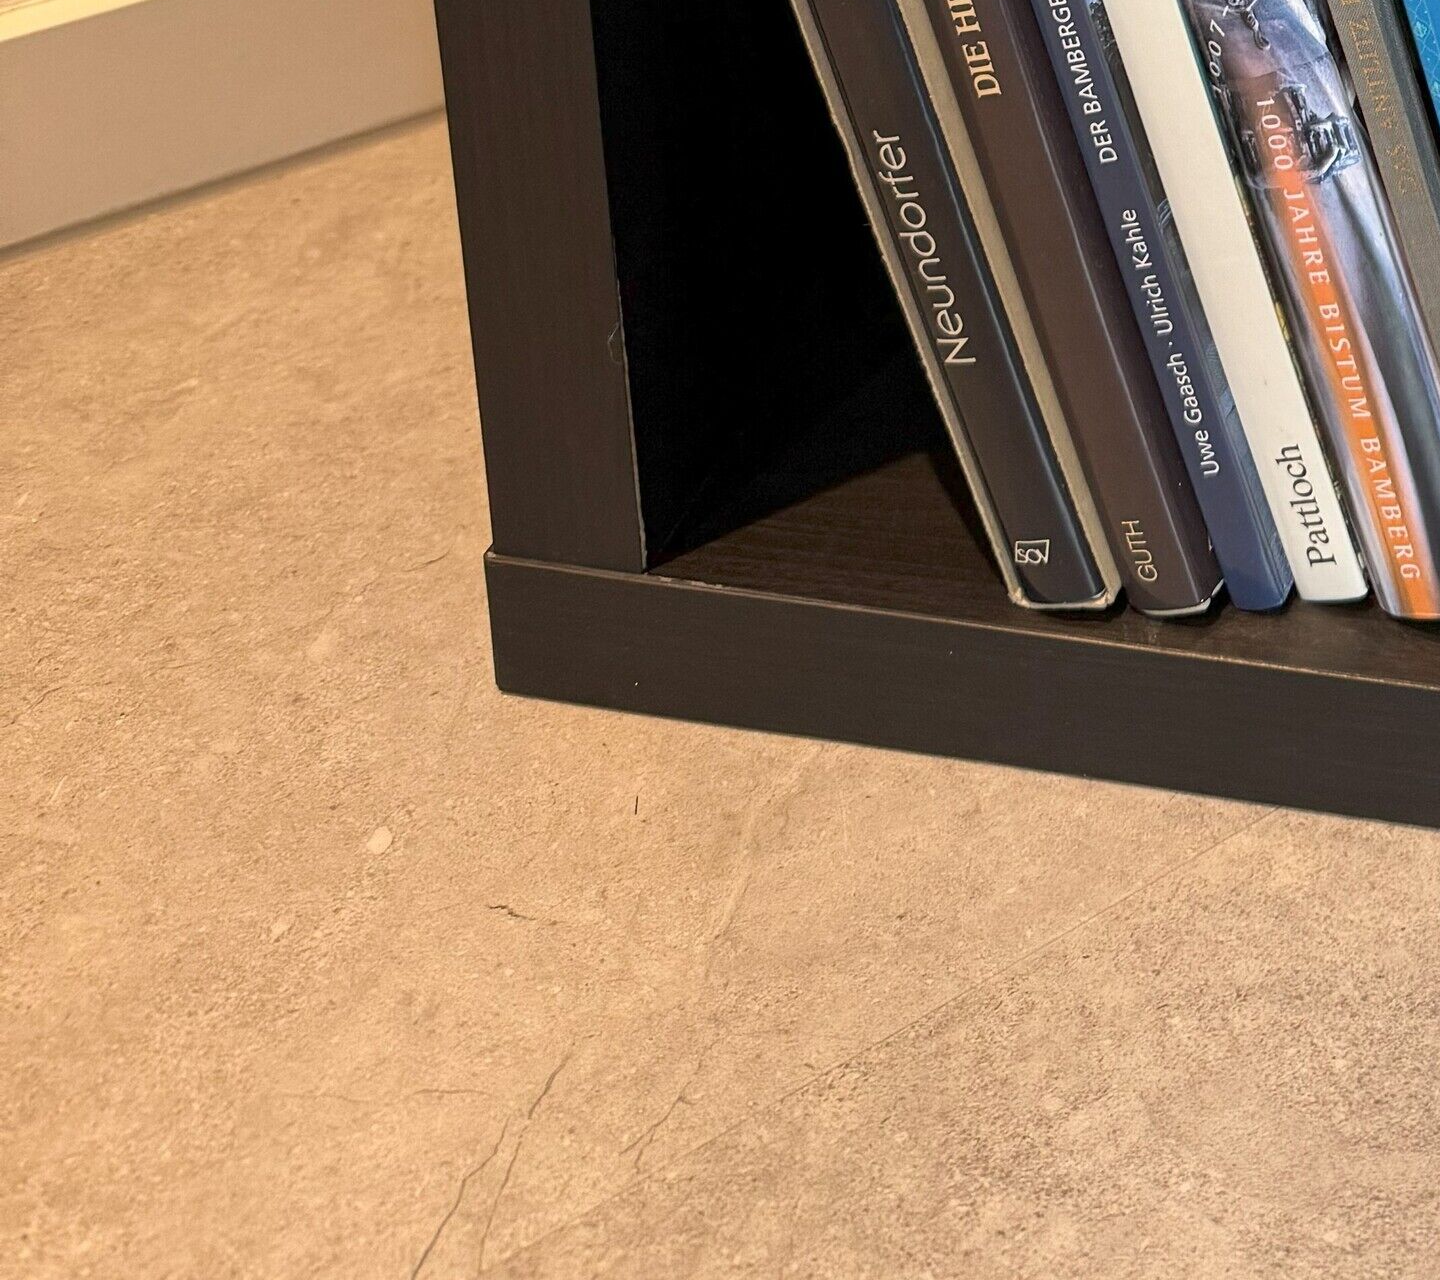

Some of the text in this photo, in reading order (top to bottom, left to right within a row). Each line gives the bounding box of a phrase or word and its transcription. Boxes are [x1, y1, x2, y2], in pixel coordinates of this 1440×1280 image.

[963, 41, 1002, 100] DIE
[1084, 119, 1118, 164] DER
[873, 130, 976, 365] Neundorfer
[1121, 208, 1219, 477] Uwe Gaasch Ulrich Kahle
[1257, 98, 1421, 581] 1000 JAHRE BISTUM BAMBERG
[1122, 519, 1158, 582] GUTH
[1275, 443, 1338, 567] Pattloch
